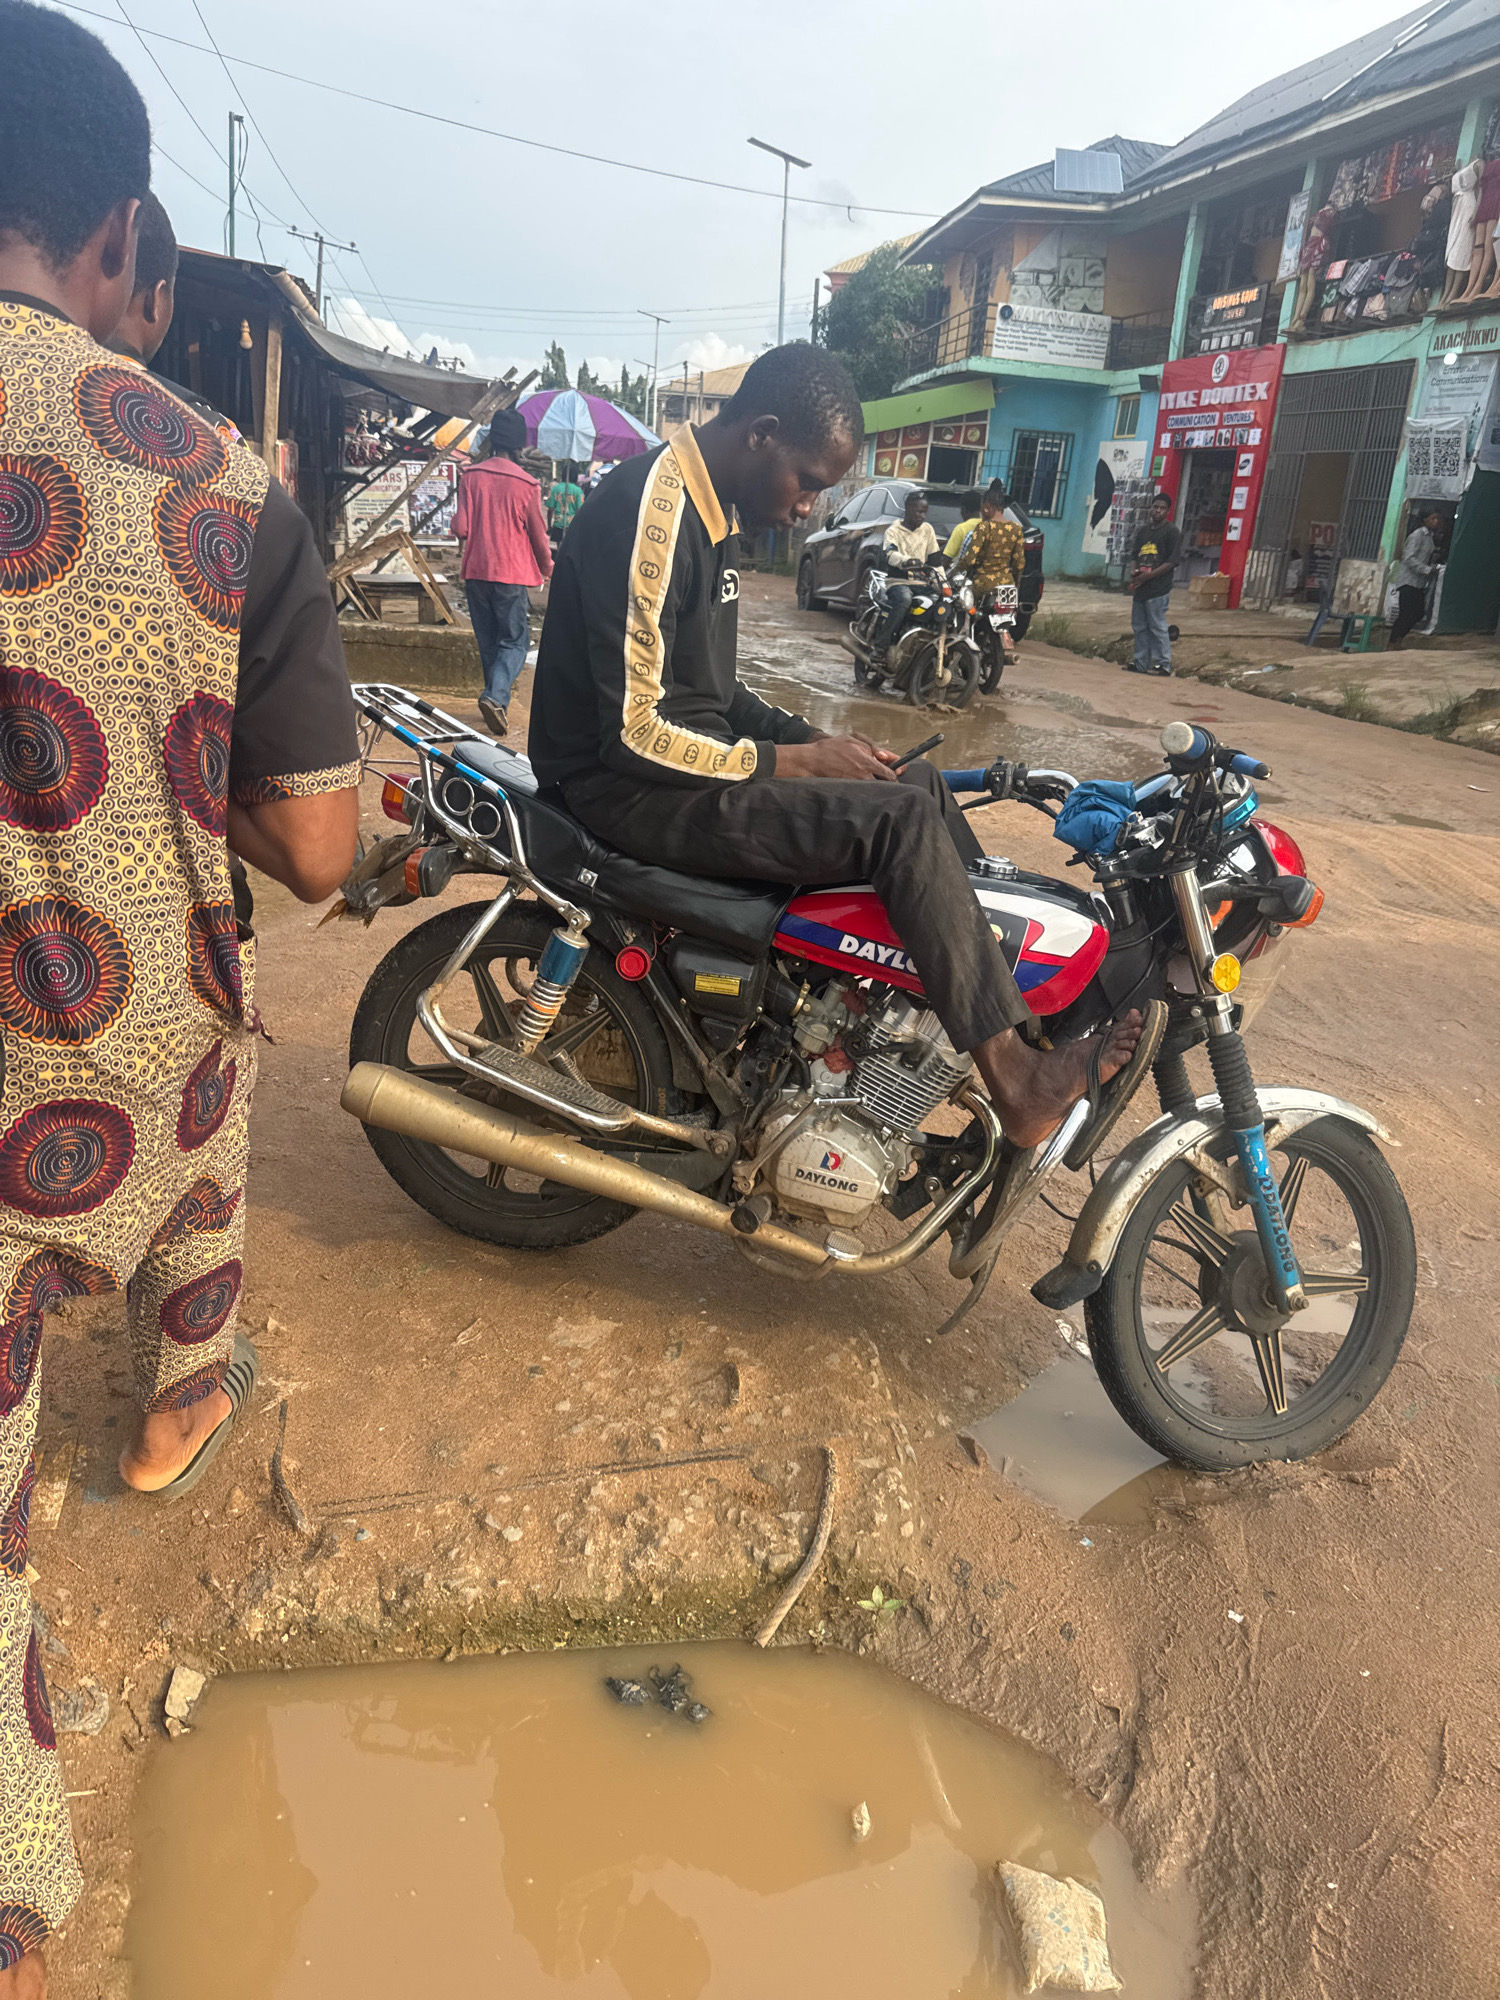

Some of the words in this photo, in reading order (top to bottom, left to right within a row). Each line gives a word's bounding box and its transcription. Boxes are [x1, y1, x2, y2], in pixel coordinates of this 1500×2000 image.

[1433, 327, 1498, 351] AKACHUKWU
[1431, 375, 1489, 387] Communications
[1160, 391, 1198, 410] IYKE
[1223, 412, 1252, 424] VENTURES
[795, 1168, 859, 1193] DAYLONG
